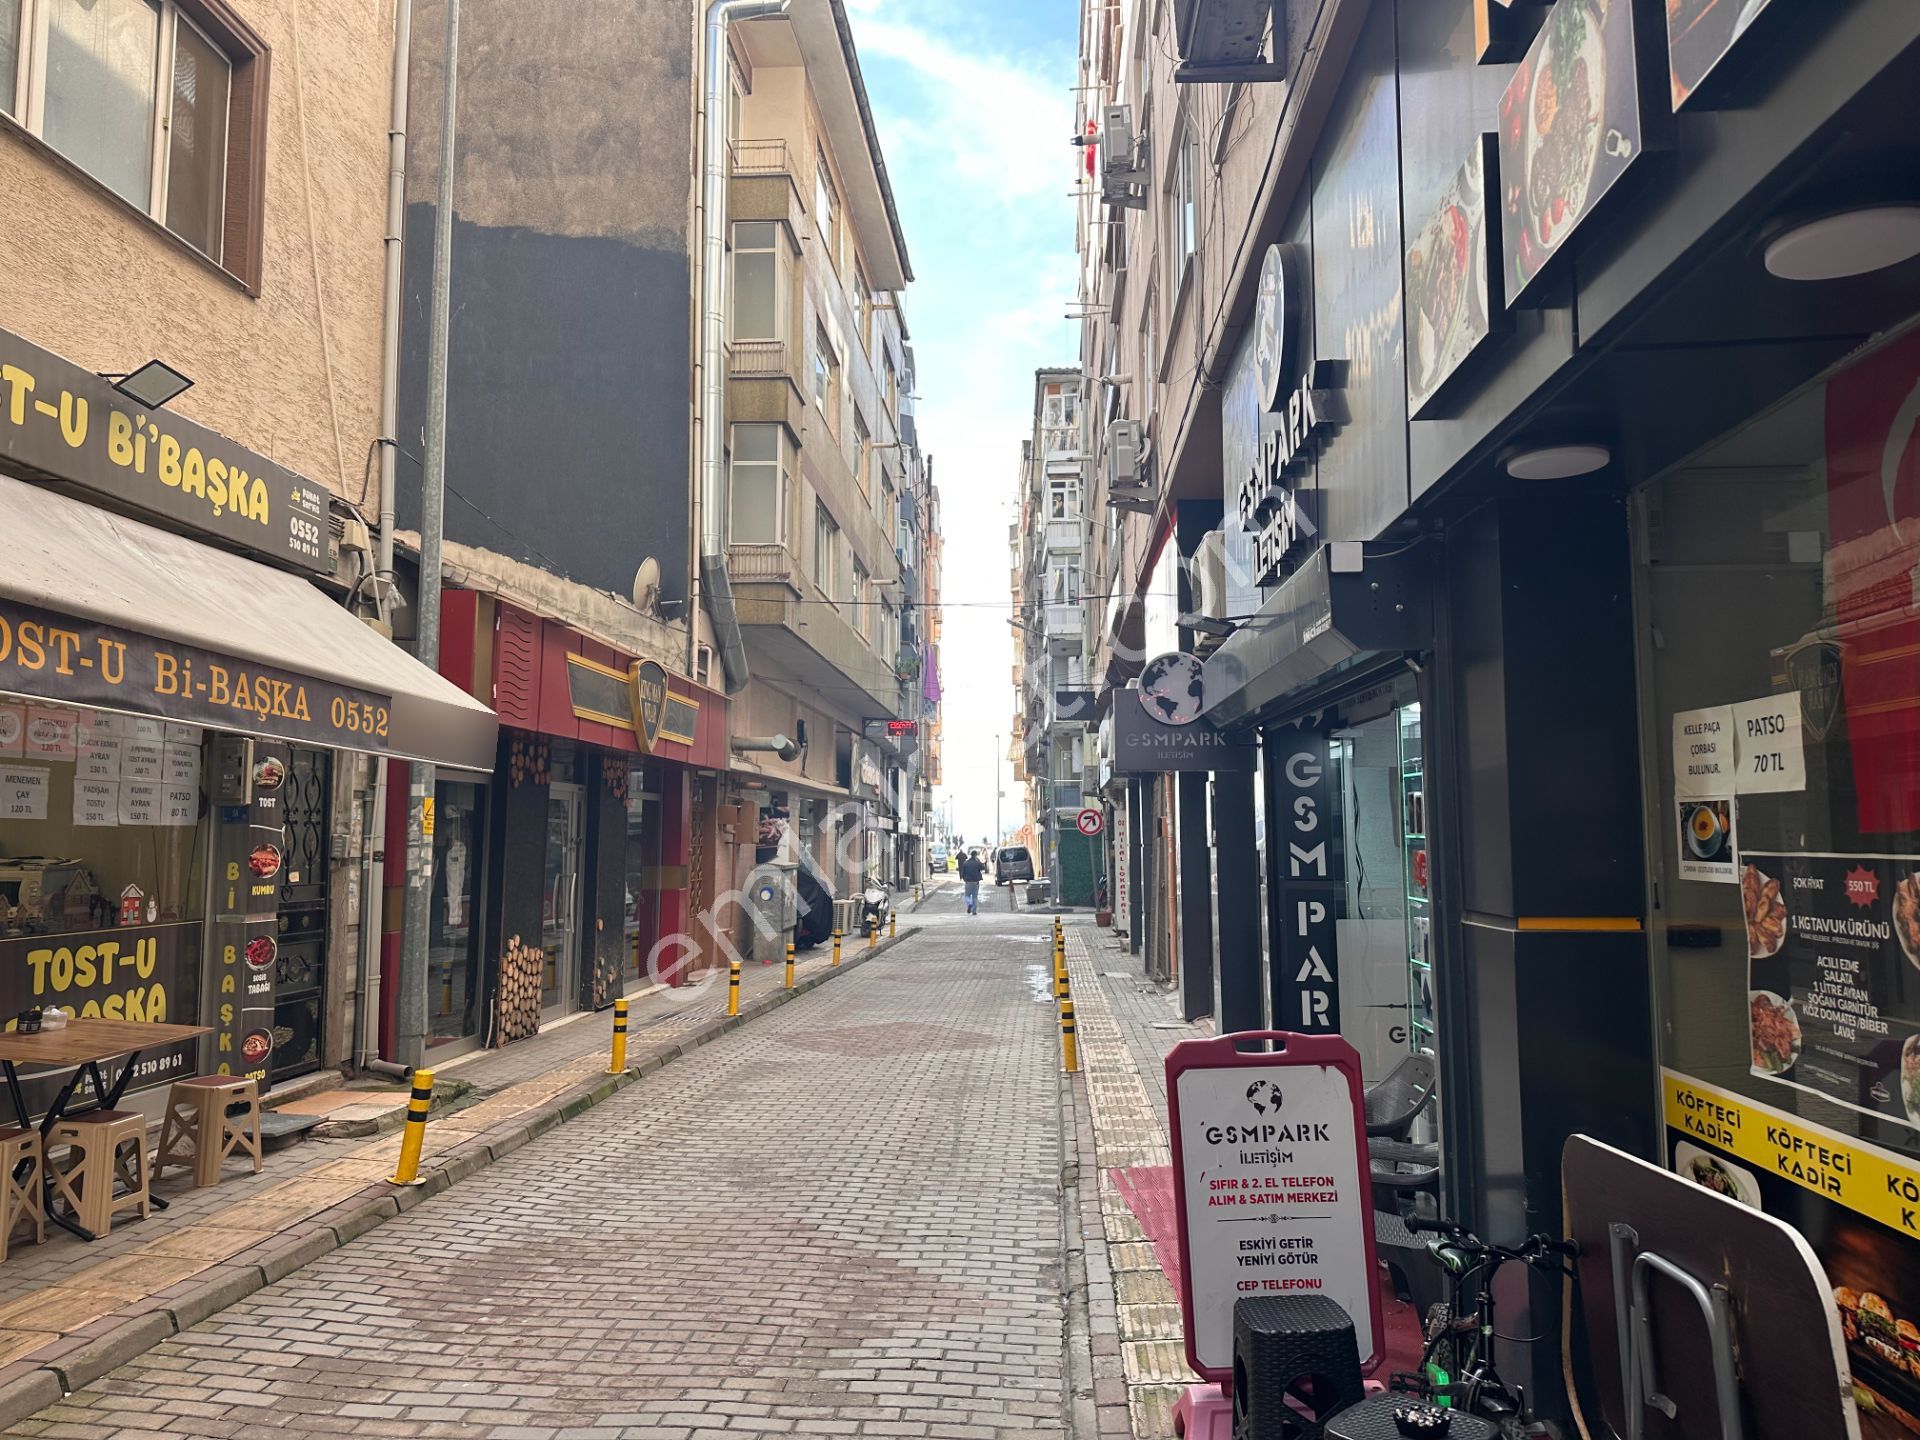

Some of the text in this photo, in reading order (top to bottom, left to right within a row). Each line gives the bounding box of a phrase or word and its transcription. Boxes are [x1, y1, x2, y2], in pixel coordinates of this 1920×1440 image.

[0, 363, 88, 449] T-U
[1237, 375, 1318, 534] GSMPARK
[290, 516, 319, 544] 0552
[289, 537, 301, 551] 510
[302, 542, 311, 554] 89
[311, 546, 319, 558] 61
[331, 695, 389, 737] 0552
[1684, 721, 1721, 736] KELLE PAÇA
[1747, 713, 1785, 738] PATSO
[1125, 732, 1227, 747] GSMPARK
[90, 752, 110, 760] AYRAN
[1690, 742, 1716, 757] ÇORBASI
[102, 766, 107, 774] TL
[1688, 763, 1721, 775] BULUNUR.
[1754, 752, 1784, 773] 70 TL
[5, 775, 41, 785] MENEMEN
[16, 790, 30, 800] ÇAY
[169, 791, 191, 801] PATSO
[259, 797, 276, 808] TOST
[11, 805, 32, 813] 120 TL
[86, 799, 105, 807] TOSTU
[130, 799, 150, 807] AYRAN
[98, 813, 104, 821] TL
[171, 808, 187, 817] 80 TL
[251, 885, 275, 896] KUMRU
[1793, 876, 1875, 893] ŞOK FİYAT 550 TL
[1792, 915, 1890, 940] 1 KG TAVUK ÜRÜNÜ
[27, 937, 156, 996] TOST-U
[1840, 958, 1860, 973] EZME
[1824, 970, 1854, 986] SALATA
[1813, 980, 1868, 1002] 1 LİTRE AYRAN
[1808, 992, 1878, 1019] SOĞAN GARNİTÜR
[1802, 1003, 1819, 1018] KÖZ
[1820, 1007, 1857, 1027] DOMATES
[1833, 1023, 1856, 1043] LAVAŞ
[141, 1062, 157, 1076] 510
[159, 1058, 171, 1071] 89
[172, 1053, 183, 1067] 61
[1677, 1089, 1742, 1130] KÖFTECİ
[1205, 1123, 1330, 1145] GSMPARK
[1685, 1113, 1735, 1149] KADİR
[1239, 1149, 1294, 1168] İLETİŞİM
[1767, 1126, 1853, 1176] KÖFTECİ
[1209, 1176, 1335, 1190] SIFIR & 2. EL TELEFON
[1778, 1153, 1842, 1198] KADİR
[1208, 1191, 1338, 1206] ALIM & SATIM MERKEZİ
[1239, 1235, 1313, 1250] ESKİYİ GETİR
[1237, 1251, 1318, 1266] YENİYİ GÖTÜR
[1236, 1278, 1322, 1291] CEP TELEFONU
